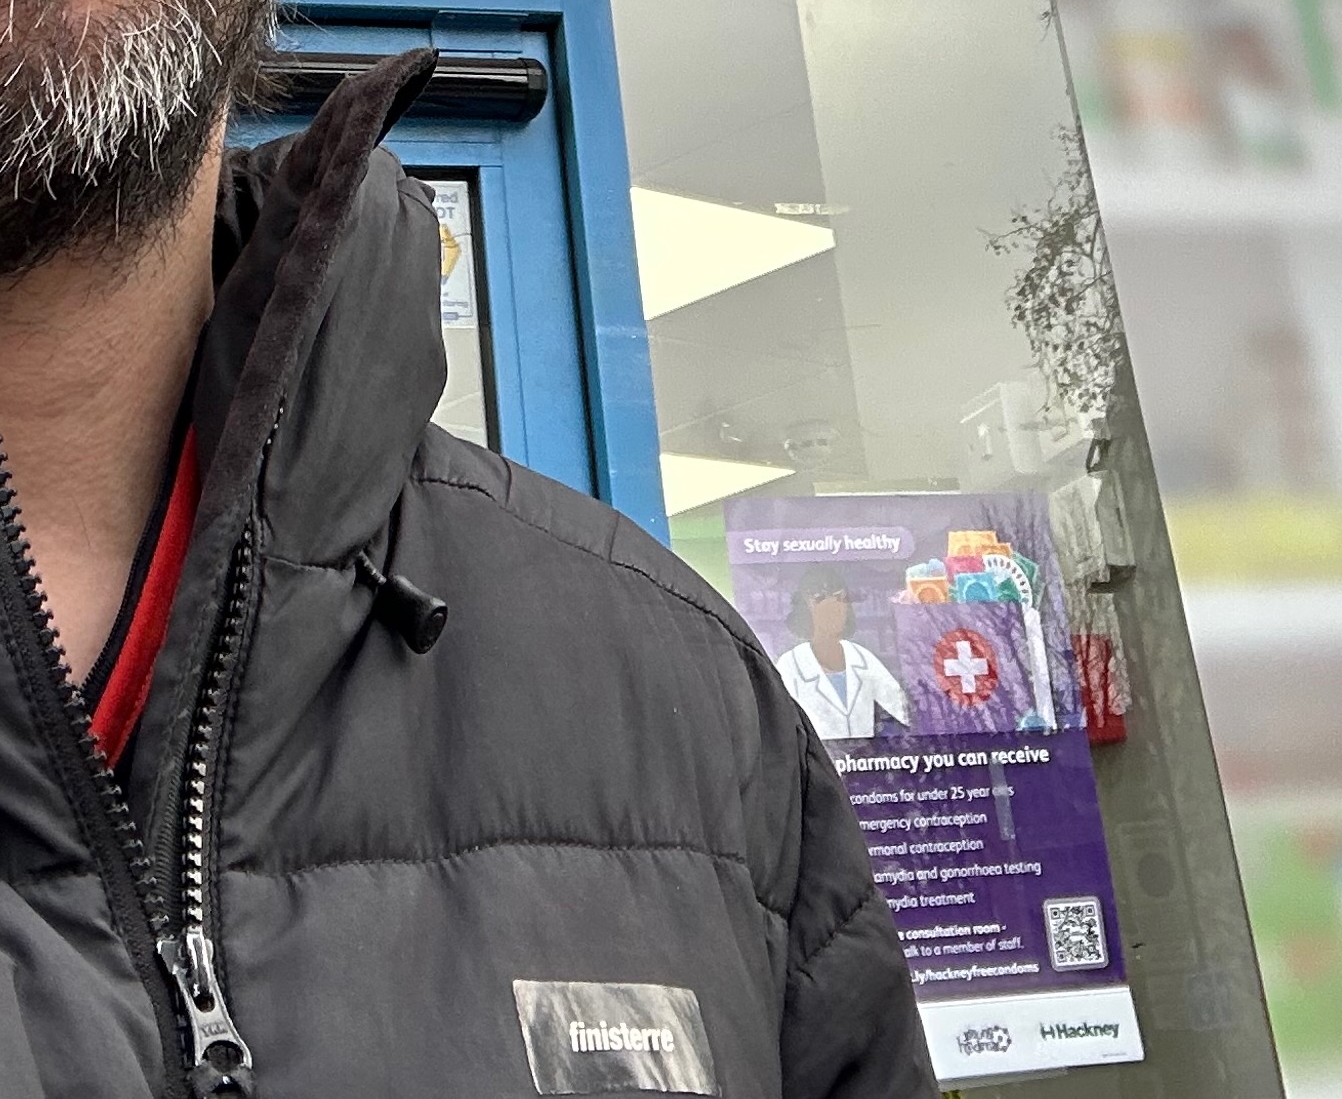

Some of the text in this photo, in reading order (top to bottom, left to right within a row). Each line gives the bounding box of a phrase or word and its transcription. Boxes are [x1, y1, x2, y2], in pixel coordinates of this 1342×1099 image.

[743, 533, 901, 556] Stay sexually healthy
[836, 745, 1050, 777] pharmacy you can receive
[849, 785, 1015, 806] condoms for under 25 year os
[913, 812, 988, 828] contraception
[909, 839, 985, 854] contraception
[916, 866, 938, 881] and
[939, 863, 1003, 883] gonorrhoea
[1004, 861, 1042, 876] testing
[919, 891, 976, 908] treatment
[905, 925, 972, 941] consultation
[972, 924, 1001, 935] room
[920, 945, 933, 957] to
[933, 945, 942, 956] a
[942, 941, 985, 955] member
[985, 938, 997, 952] of
[568, 1019, 675, 1053] finisterre
[1056, 1021, 1120, 1040] Hackney
